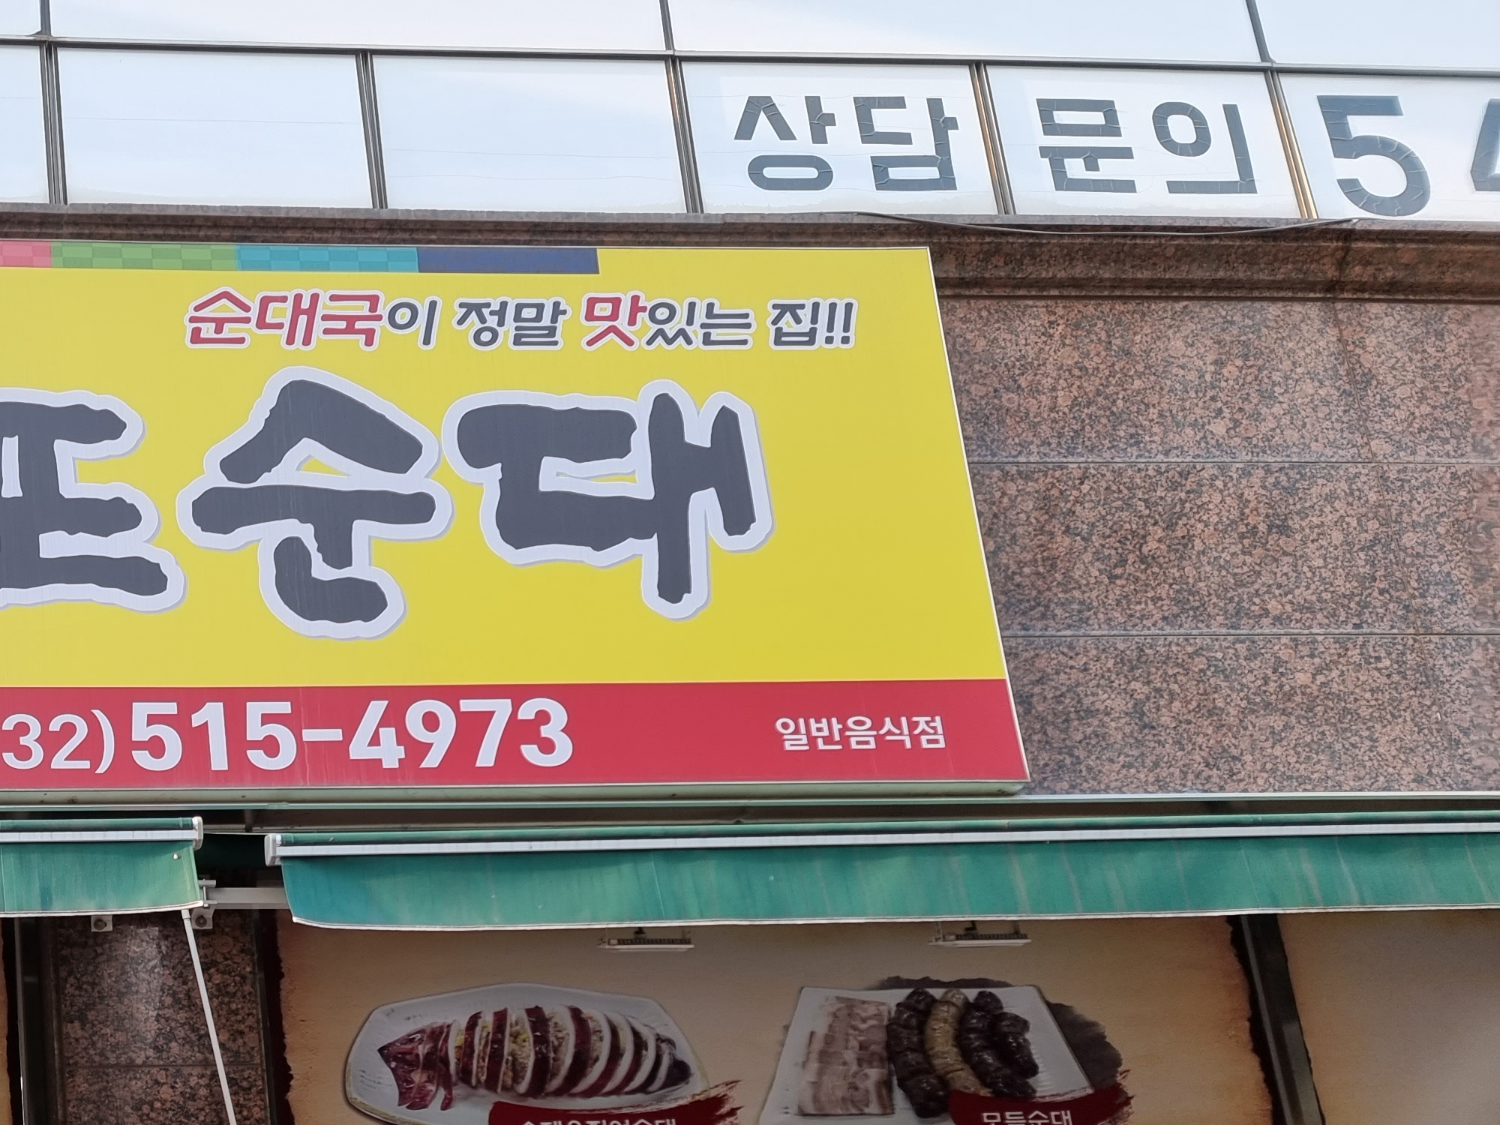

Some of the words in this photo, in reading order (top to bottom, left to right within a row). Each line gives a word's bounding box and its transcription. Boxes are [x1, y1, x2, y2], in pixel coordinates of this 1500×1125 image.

[734, 95, 960, 192] 상담
[1036, 98, 1259, 195] 문의
[186, 288, 437, 350] 순대국이
[453, 292, 567, 350] 정말
[581, 292, 753, 351] 맛있는
[766, 296, 857, 351] 집!!
[775, 715, 946, 753] 일반음식점
